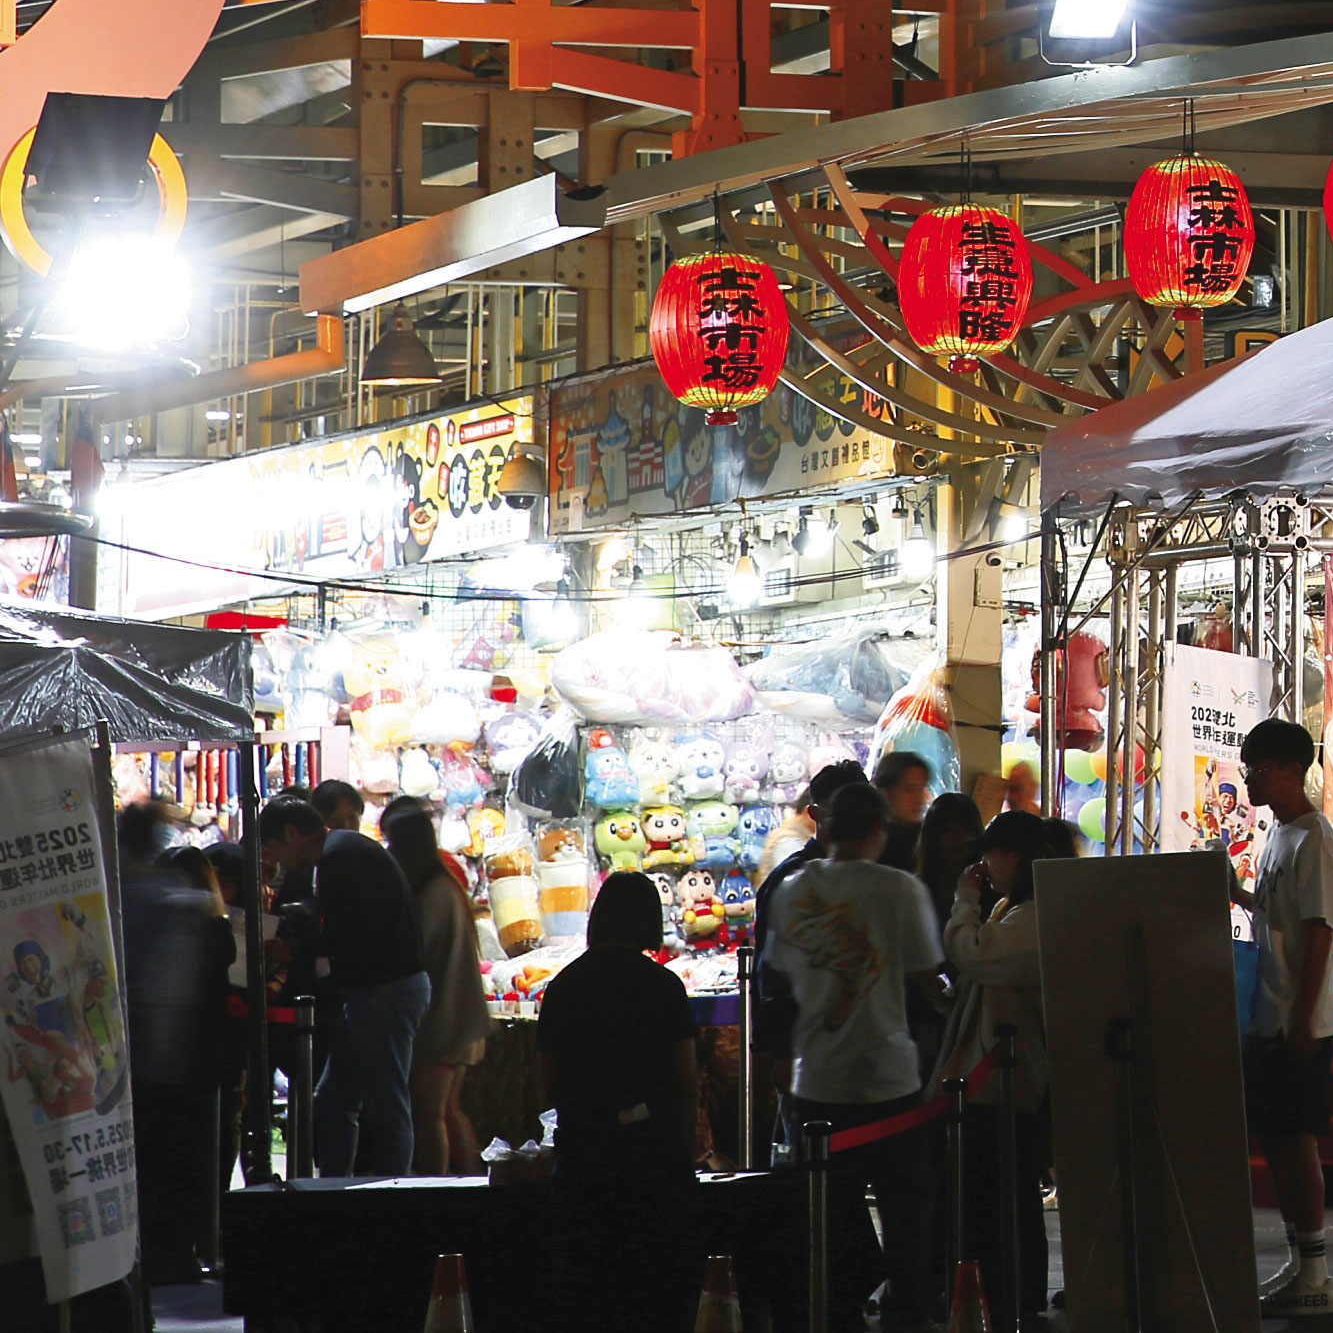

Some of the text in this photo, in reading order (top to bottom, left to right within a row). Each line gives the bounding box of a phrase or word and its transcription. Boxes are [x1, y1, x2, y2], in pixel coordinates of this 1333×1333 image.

[1183, 179, 1245, 293] 士林市場
[697, 267, 766, 389] 士林市場
